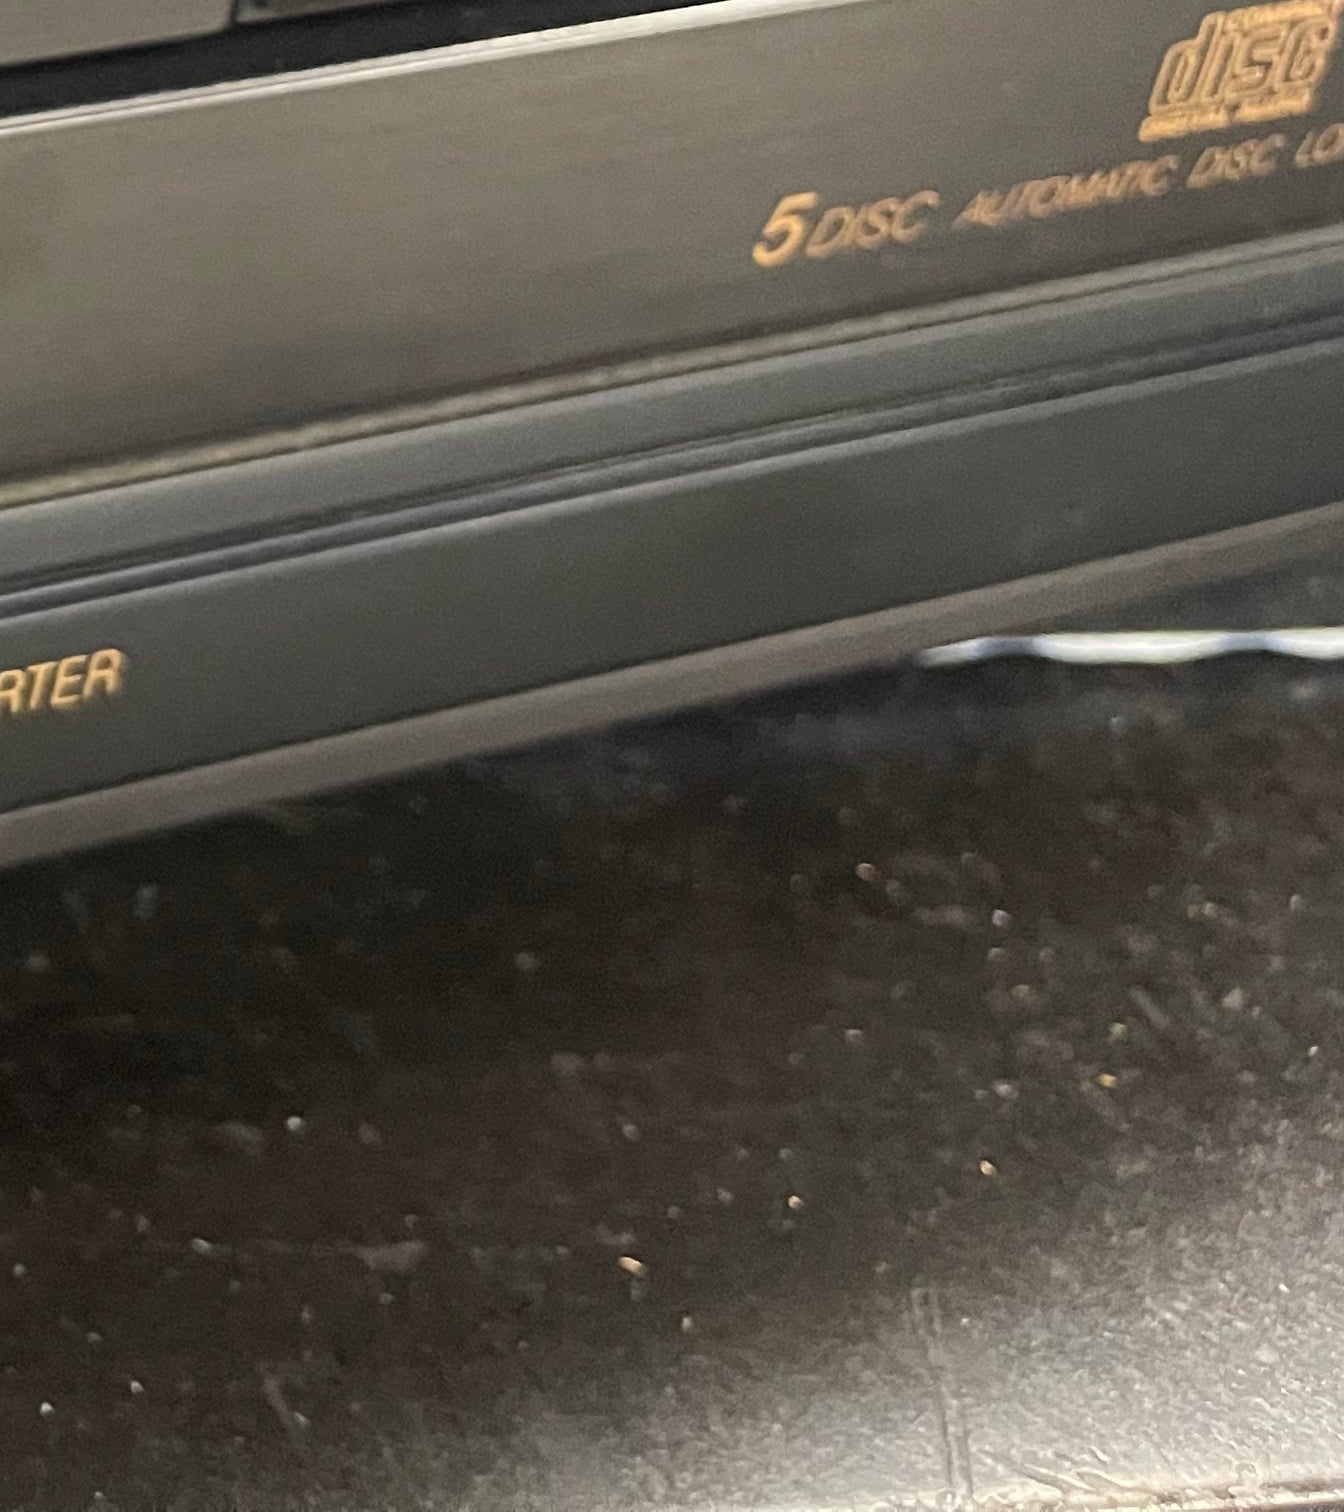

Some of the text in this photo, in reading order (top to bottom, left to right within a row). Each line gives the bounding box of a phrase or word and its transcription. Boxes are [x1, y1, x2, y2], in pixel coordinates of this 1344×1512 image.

[752, 191, 819, 267] 5
[805, 190, 941, 260] DISC
[954, 154, 1180, 230] AUTOMATIC
[1186, 133, 1287, 187] DISC
